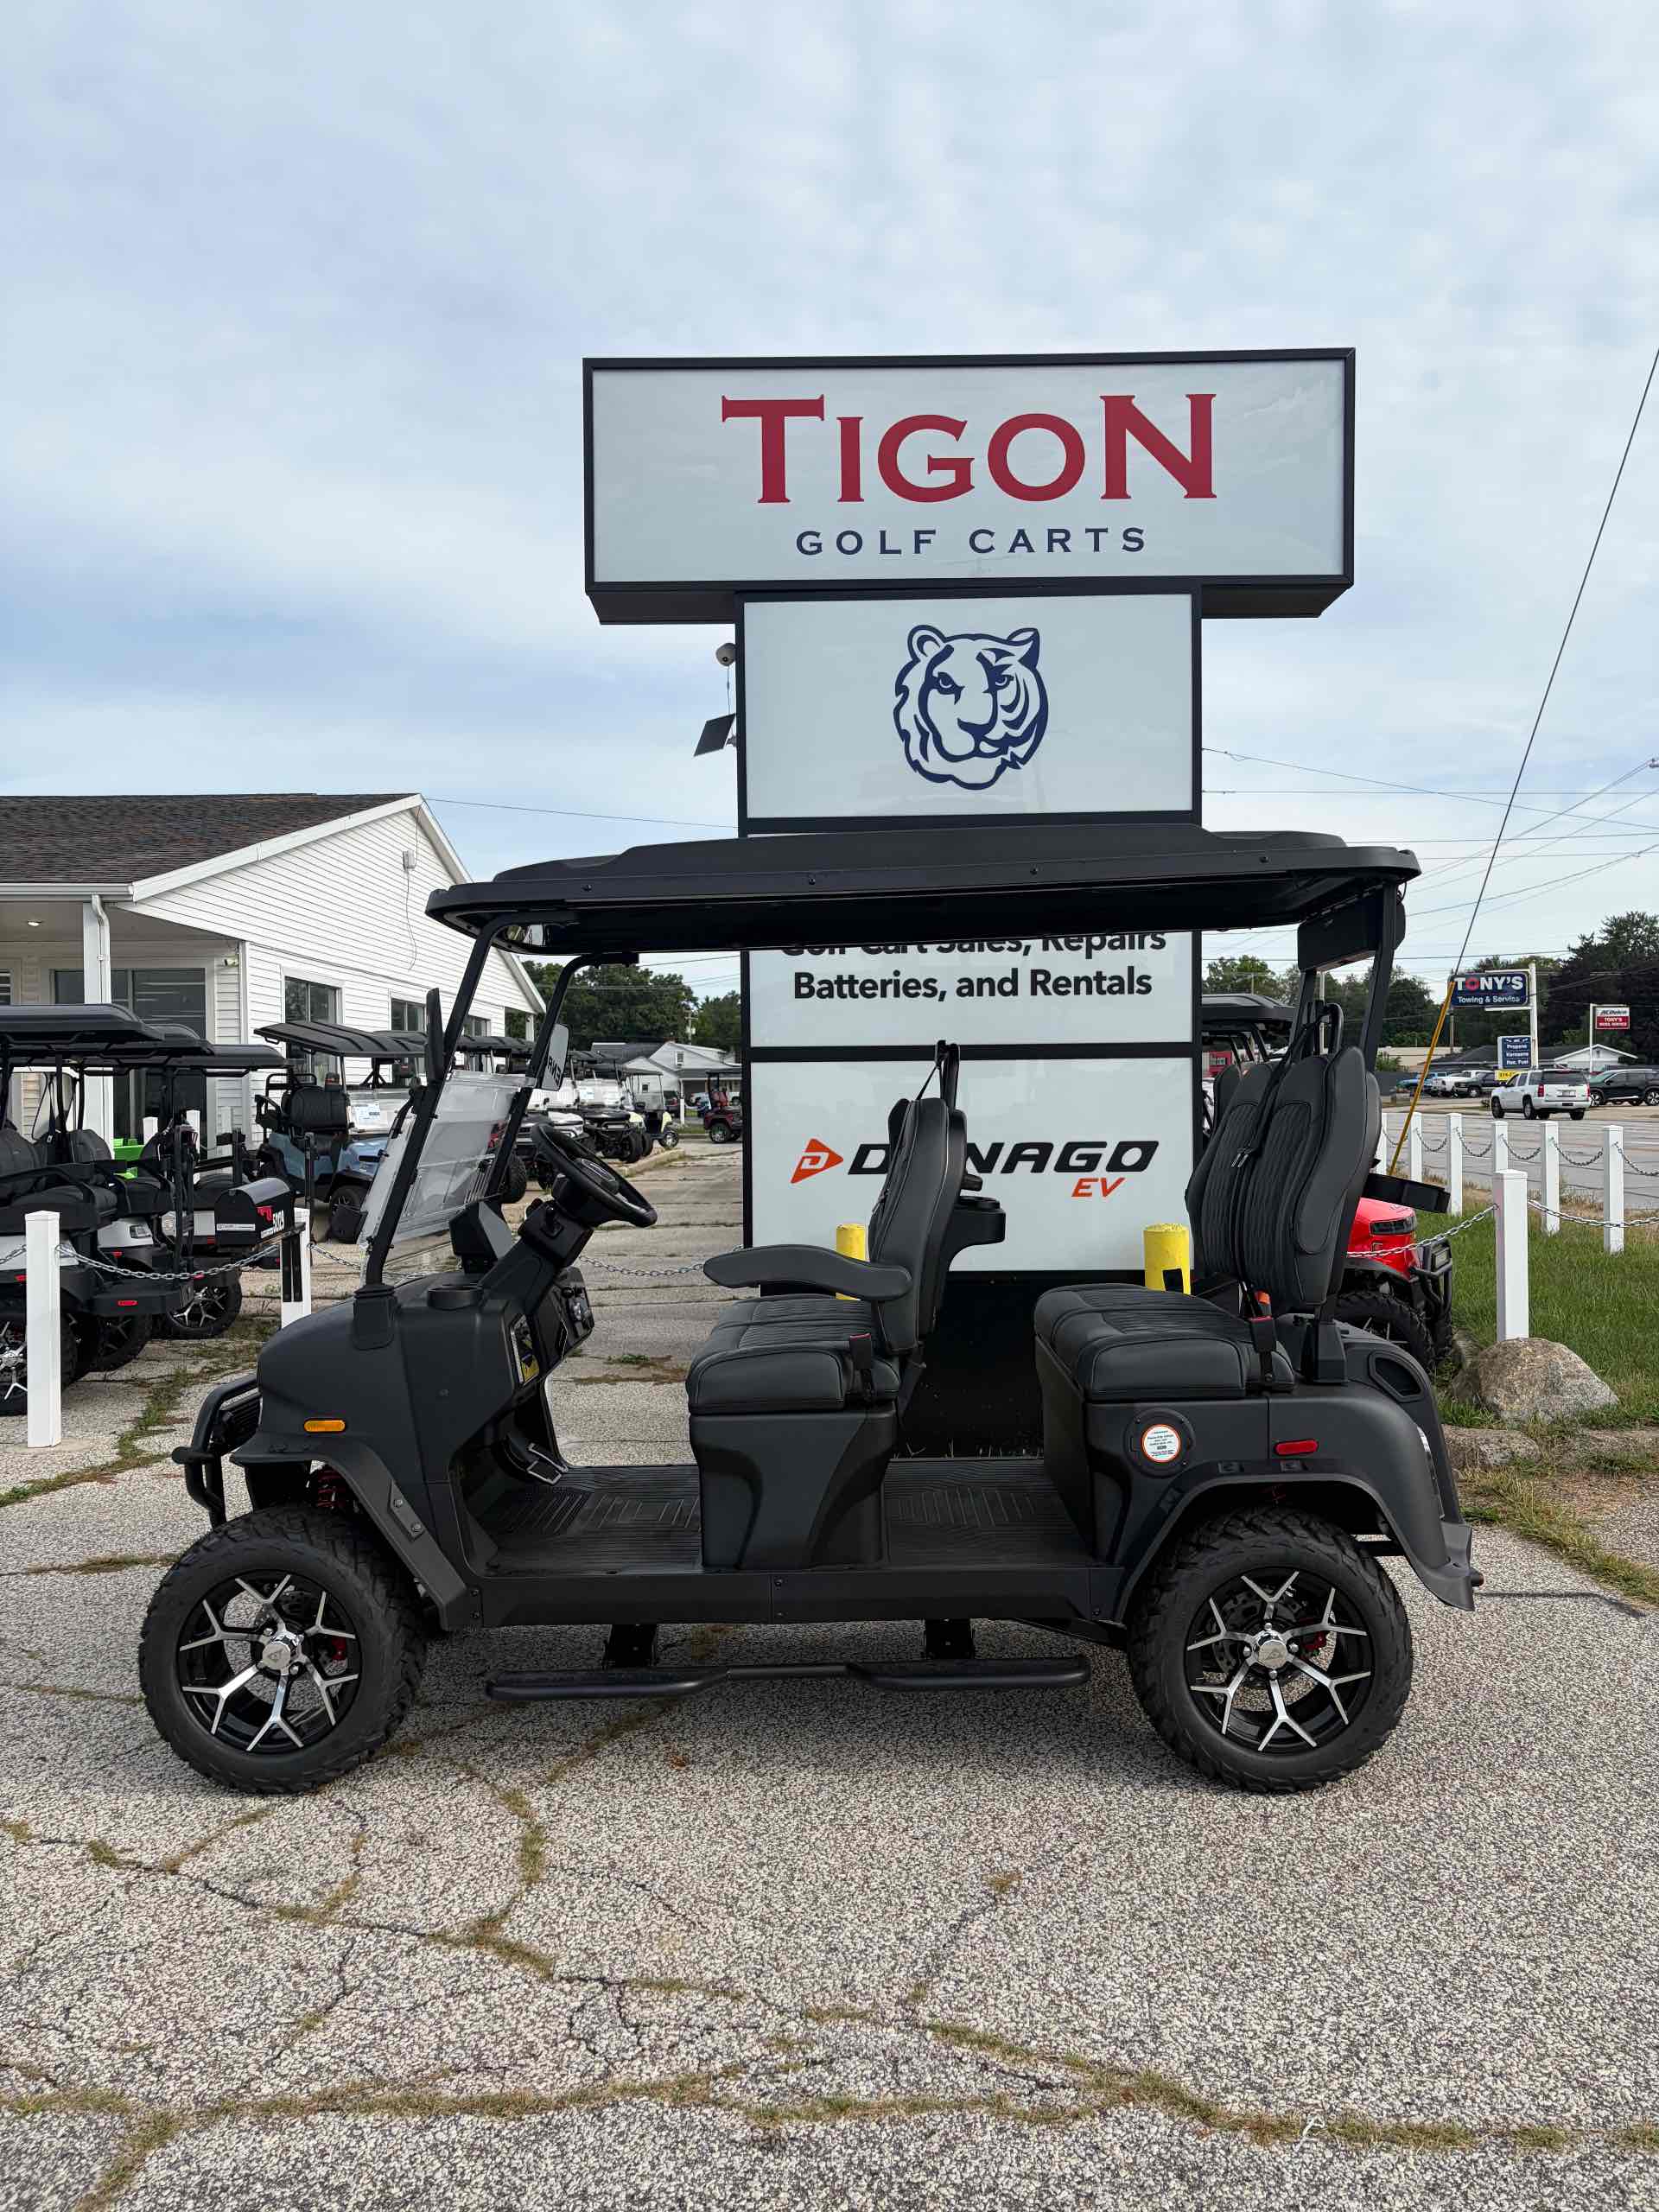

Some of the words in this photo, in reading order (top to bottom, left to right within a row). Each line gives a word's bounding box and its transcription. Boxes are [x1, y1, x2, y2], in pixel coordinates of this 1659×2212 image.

[722, 394, 1217, 503] TIGON
[796, 530, 937, 556] GOLF
[969, 527, 1145, 554] CARTS
[794, 969, 947, 1002] Batteries,
[956, 967, 1019, 997] and
[1030, 965, 1153, 995] Rentals
[1453, 976, 1523, 991] TONY'S
[1458, 995, 1484, 1004] Towing
[1492, 995, 1521, 1003] Service
[848, 1140, 1160, 1175] DNAGO
[1071, 1177, 1126, 1198] EV
